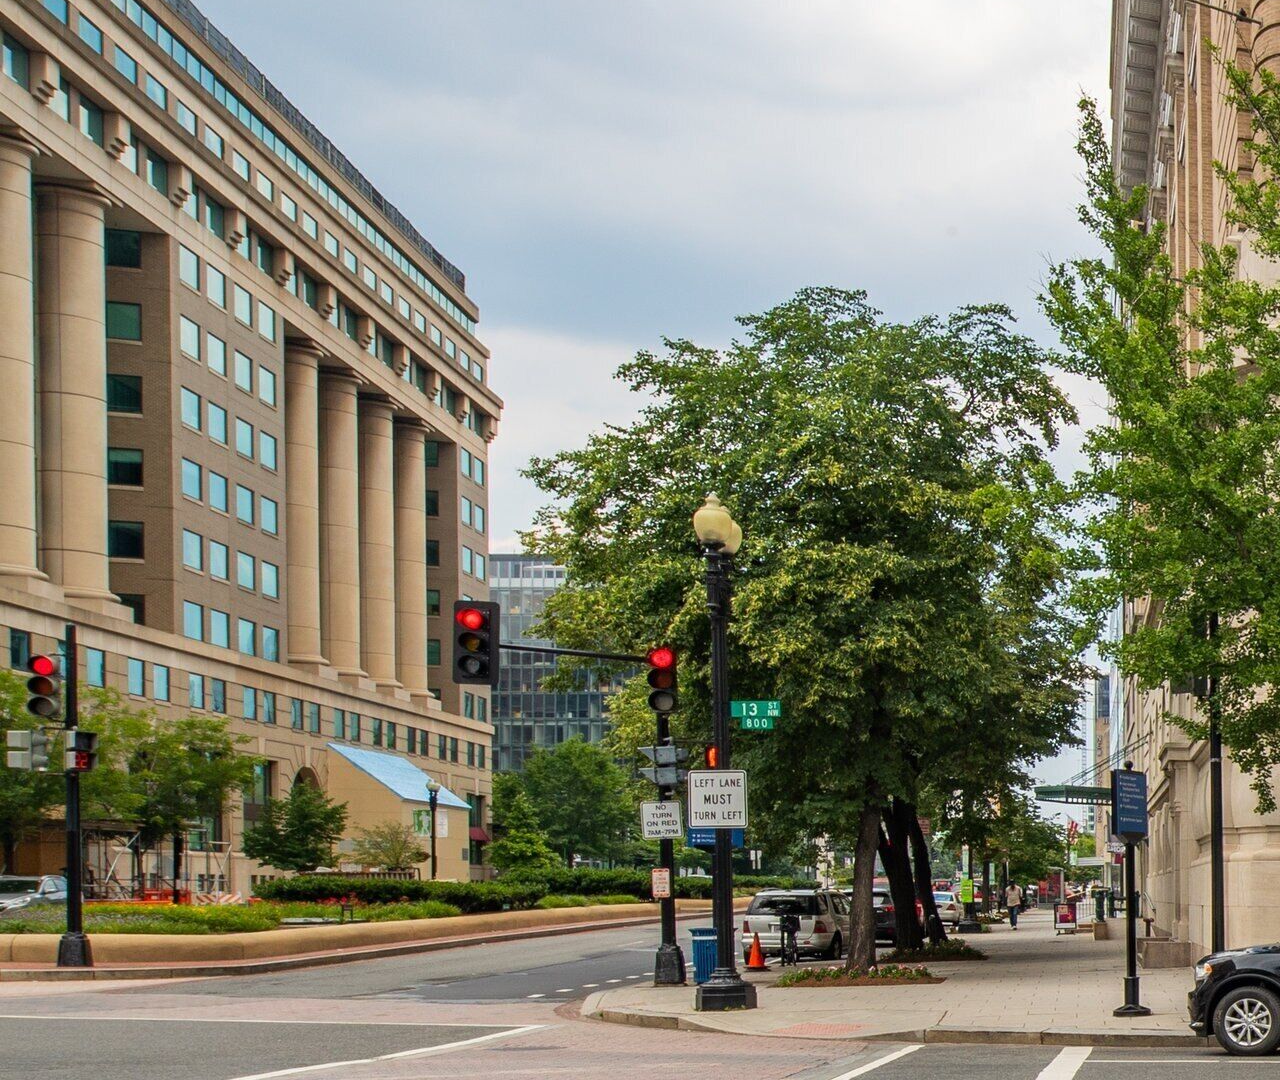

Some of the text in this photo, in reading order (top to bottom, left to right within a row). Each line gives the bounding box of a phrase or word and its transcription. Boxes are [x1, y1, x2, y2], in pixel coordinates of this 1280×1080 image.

[741, 702, 758, 716] 13
[746, 718, 768, 728] 800
[694, 778, 742, 788] LEFT LANE
[703, 793, 732, 805] MUST
[694, 811, 743, 820] TURN LEFT
[661, 819, 678, 827] RED
